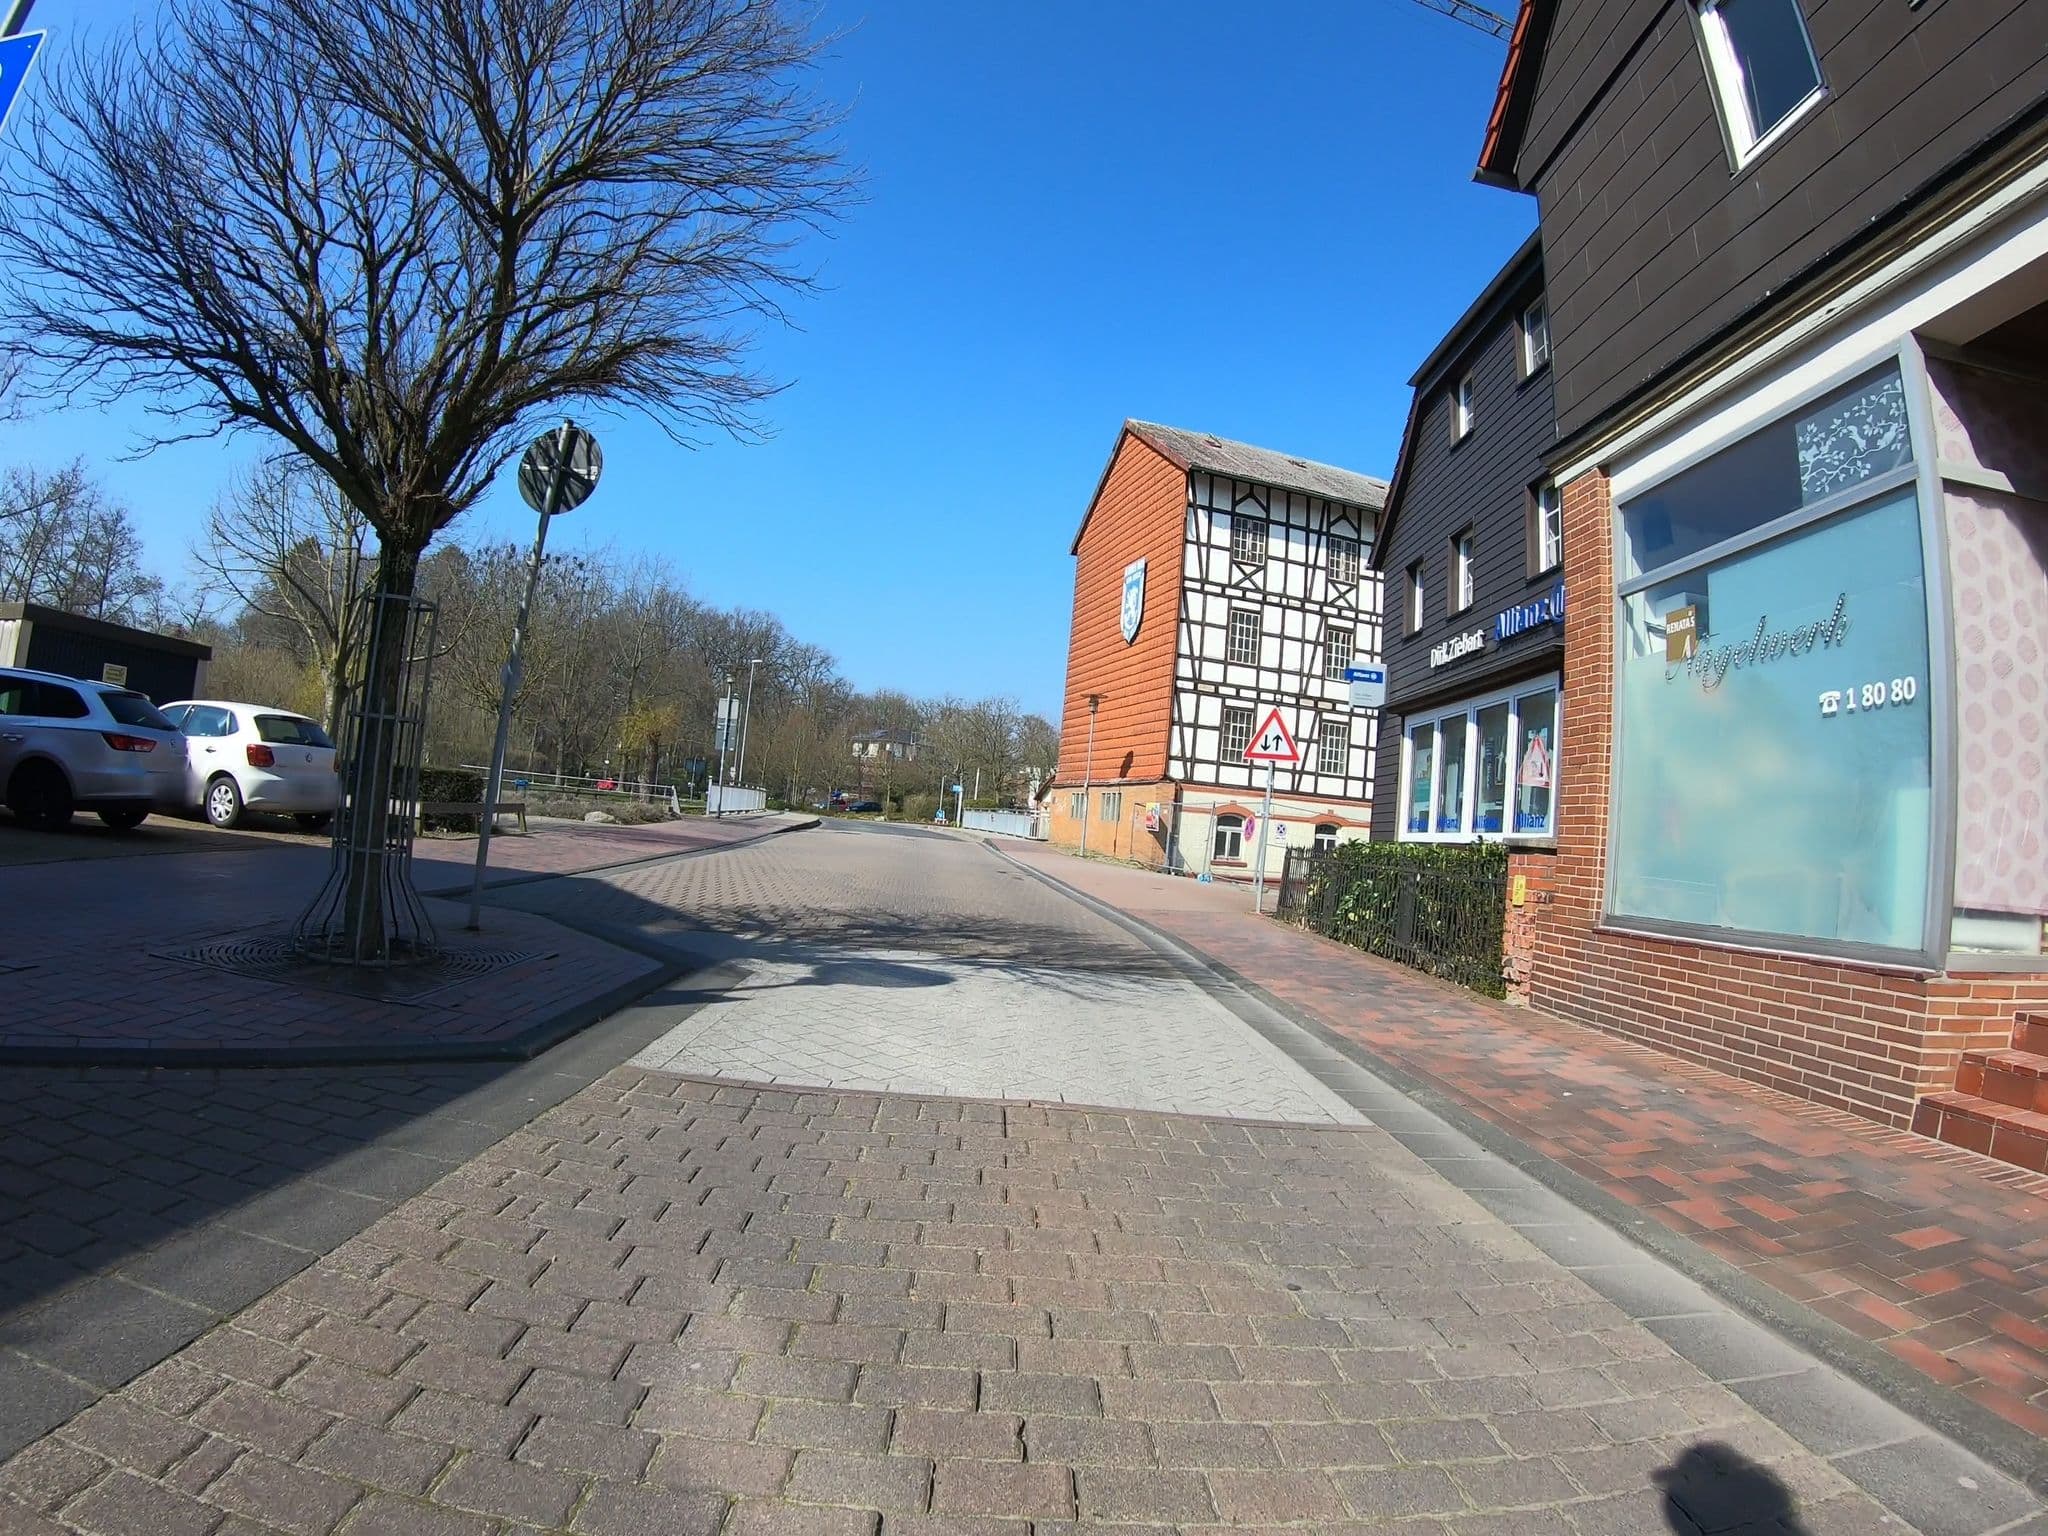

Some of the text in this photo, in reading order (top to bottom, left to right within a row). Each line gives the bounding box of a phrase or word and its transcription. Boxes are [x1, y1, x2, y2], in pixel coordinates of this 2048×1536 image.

[1493, 598, 1549, 641] Allianz
[1430, 629, 1485, 669] Dirk Ziebart
[1846, 675, 1917, 710] 1 80 80
